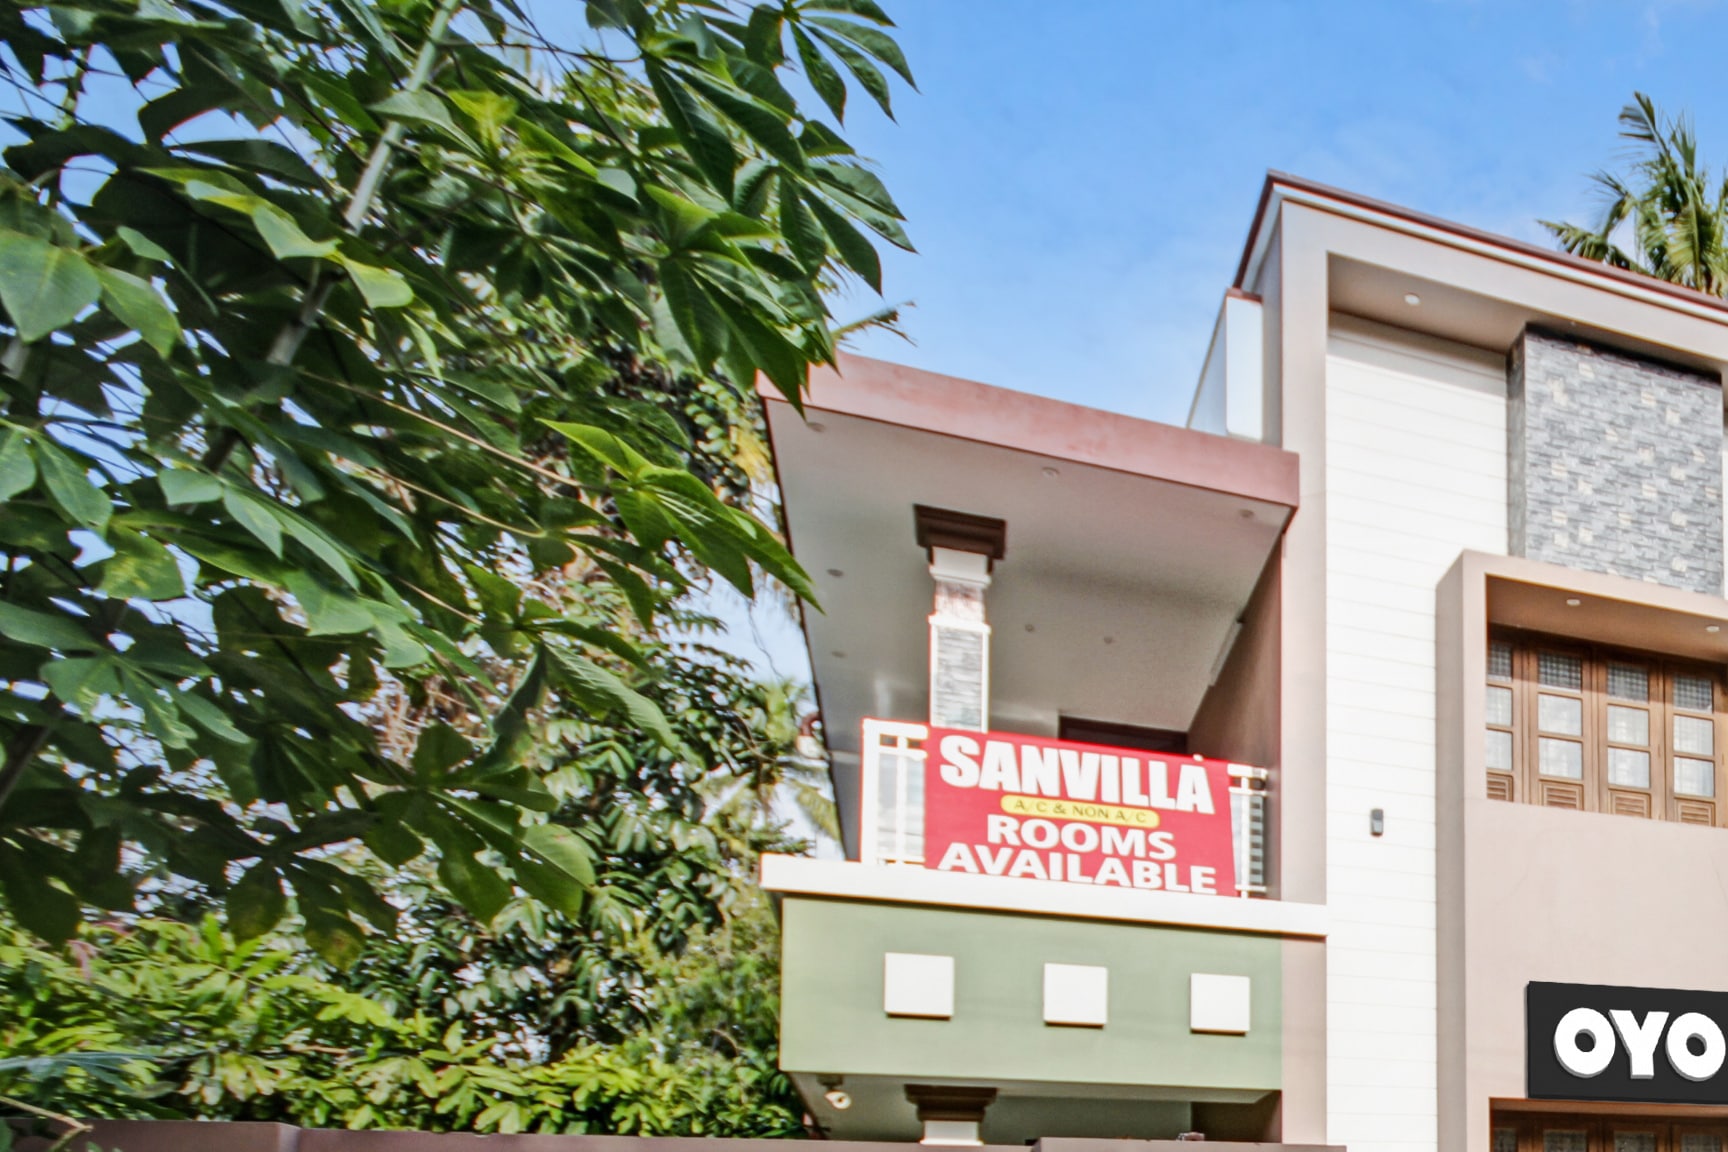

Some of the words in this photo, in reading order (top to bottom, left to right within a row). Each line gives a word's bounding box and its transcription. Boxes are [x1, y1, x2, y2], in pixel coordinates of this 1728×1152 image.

[939, 735, 1215, 814] SANVILLA
[987, 814, 1176, 860] ROOMS
[1014, 799, 1048, 813] A/C
[1053, 803, 1067, 815] &
[1073, 805, 1109, 819] NON
[1115, 810, 1147, 823] A/C
[938, 842, 1217, 894] AVAILABLE
[1553, 1007, 1726, 1082] OYO
